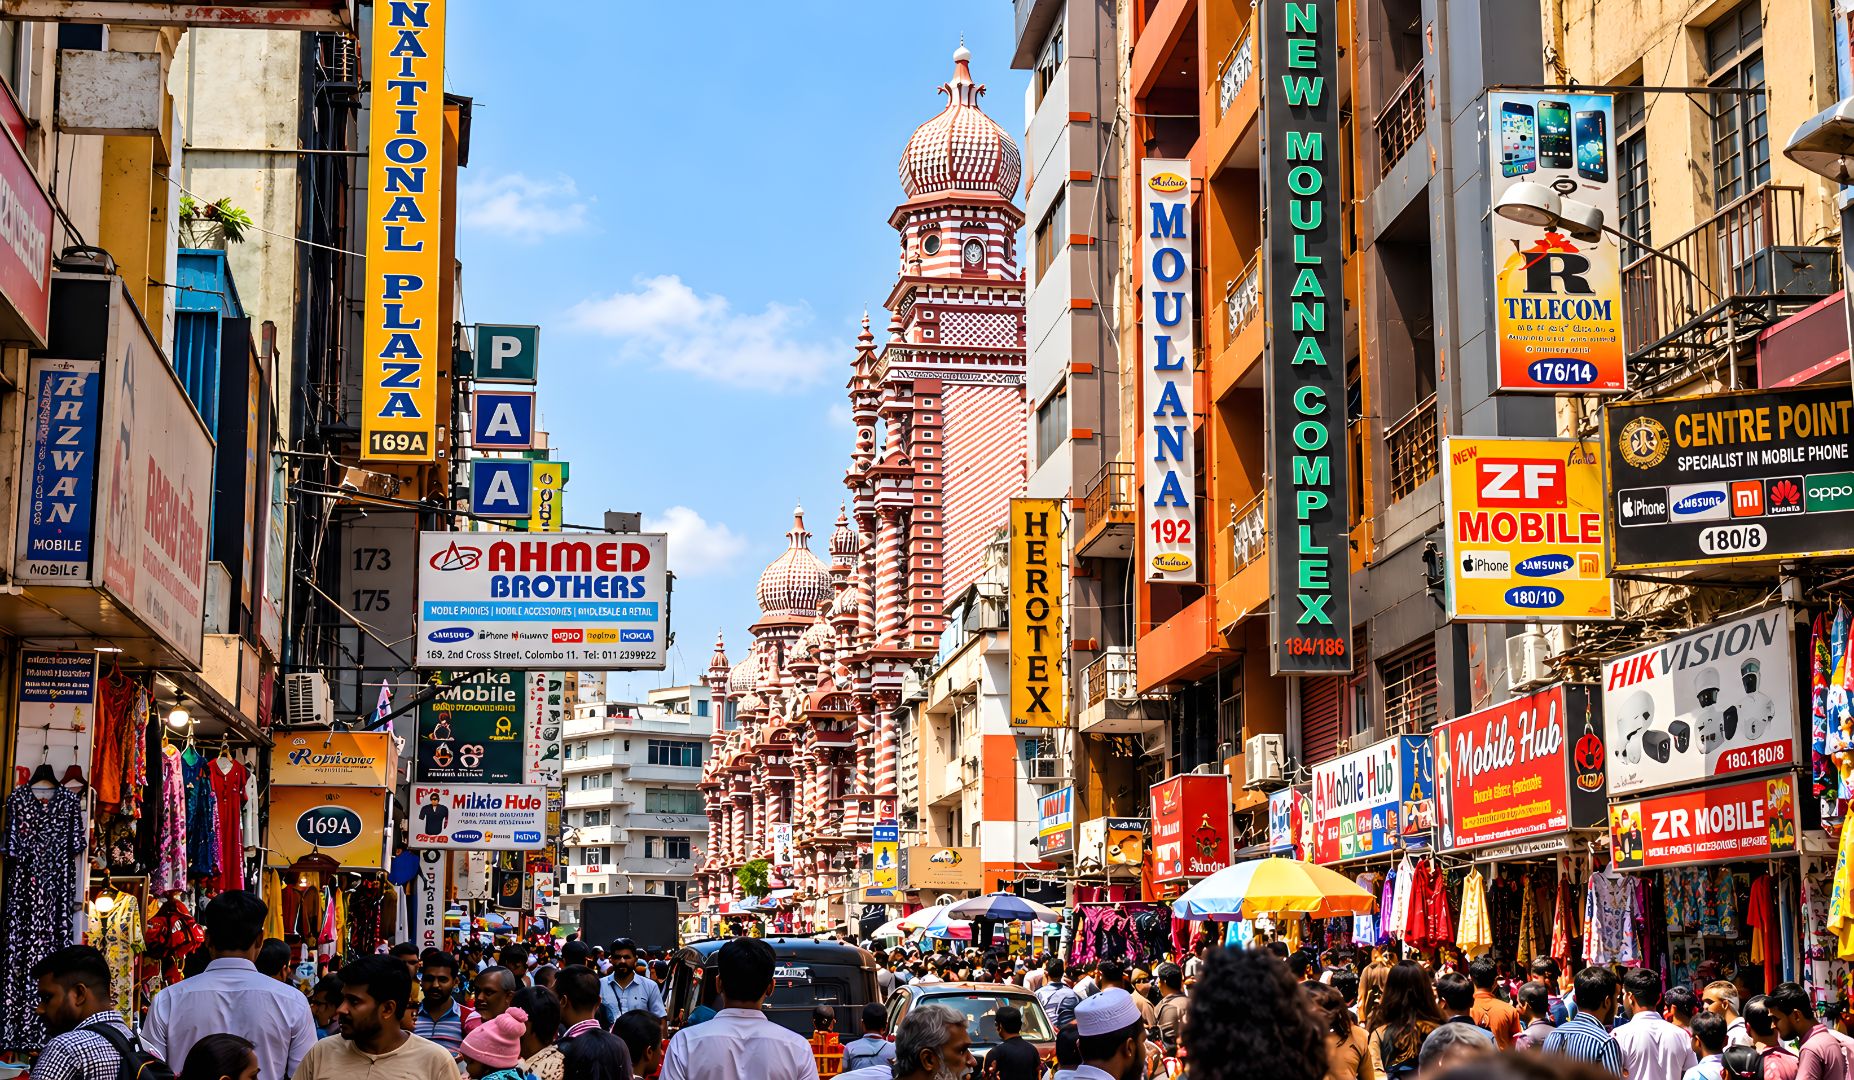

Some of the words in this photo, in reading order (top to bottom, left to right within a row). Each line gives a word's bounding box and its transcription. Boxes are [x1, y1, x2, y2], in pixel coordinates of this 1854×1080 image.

[1282, 2, 1324, 107] NEW
[1286, 130, 1327, 366] MOULANA
[1504, 297, 1612, 322] TELECOM
[377, 273, 425, 419] PLAZA
[490, 335, 522, 370] P
[1150, 202, 1190, 507] MOULANA
[1533, 362, 1593, 383] 176/14
[484, 403, 522, 437] A
[1674, 407, 1771, 449] CENTRE
[1777, 400, 1853, 440] POINT
[371, 434, 425, 452] 169A
[1453, 446, 1478, 466] NEW
[1677, 451, 1744, 472] SPECIALIST
[1746, 450, 1758, 467] IN
[1761, 446, 1805, 465] MOBILE
[1808, 443, 1849, 462] PHONE
[482, 470, 520, 506] A
[1481, 463, 1557, 499] ZF
[1808, 485, 1853, 501] oppo
[1292, 385, 1333, 626] COMPLEX
[1150, 519, 1191, 544] 192
[1458, 511, 1602, 545] MOBILE
[1705, 527, 1762, 551] 180/8
[33, 539, 82, 552] MOBILE
[353, 547, 391, 571] 173
[488, 541, 651, 572] AHMED
[1474, 557, 1509, 573] iPhone
[1522, 560, 1569, 571] SAMSUNG
[352, 588, 391, 612] 175
[490, 574, 646, 599] BROTHERS
[1512, 591, 1557, 605] 180/10
[1024, 511, 1051, 713] HEROTEX
[447, 650, 464, 660] 2nd
[466, 650, 491, 660] Cross
[524, 650, 564, 660] Colombo
[566, 650, 579, 660] 11.
[583, 650, 600, 660] Tel:
[602, 651, 617, 660] 011
[1285, 637, 1345, 657] 184/186
[1607, 613, 1779, 692] HIKVISION
[435, 686, 516, 702] Mobile
[1456, 715, 1515, 787] Mobile
[1518, 700, 1562, 763] Hub
[1726, 745, 1785, 769] 180.180/8
[1326, 761, 1364, 810] Mobile
[1367, 750, 1393, 798] Hub
[307, 816, 352, 835] 169A
[1651, 808, 1689, 841] ZR
[1694, 799, 1765, 834] MOBILE
